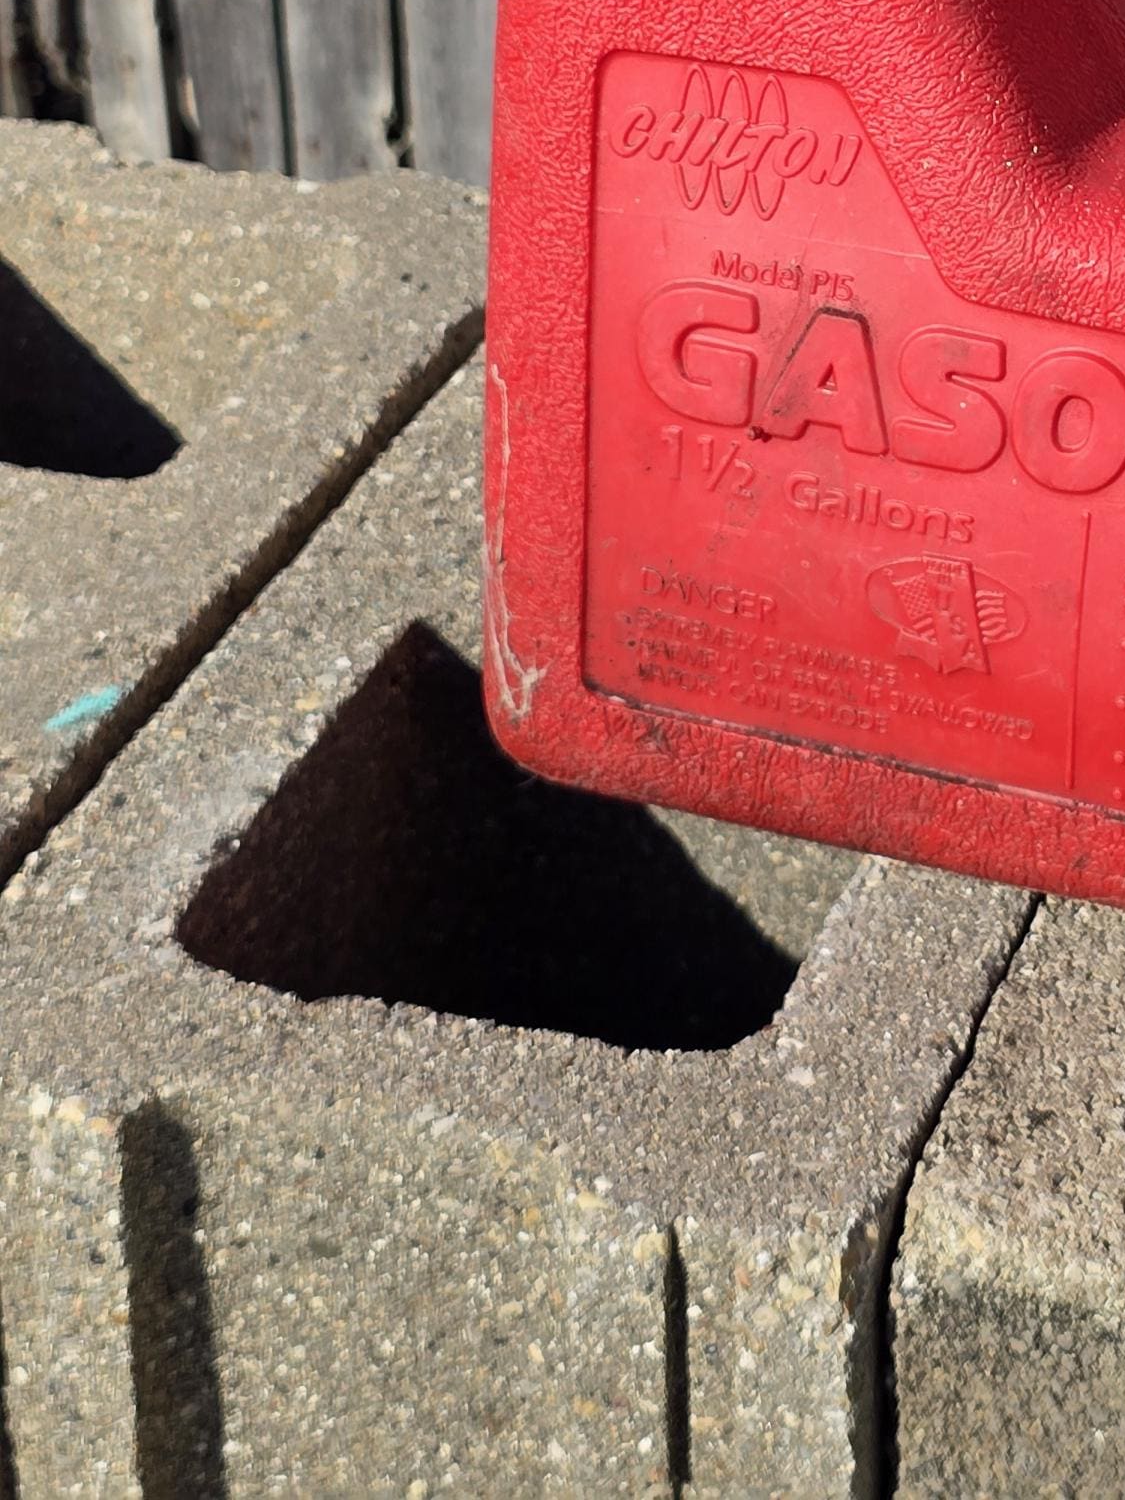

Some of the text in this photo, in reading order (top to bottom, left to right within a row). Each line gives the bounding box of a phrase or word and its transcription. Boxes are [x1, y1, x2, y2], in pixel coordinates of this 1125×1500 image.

[608, 105, 862, 187] CHILTON
[708, 246, 805, 292] Model
[784, 469, 976, 545] Gallons
[634, 564, 781, 625] DANGER
[632, 604, 900, 685] EXTREMELY FLAMMABLE
[725, 678, 785, 713] CAN
[783, 690, 892, 736] EXPLODE
